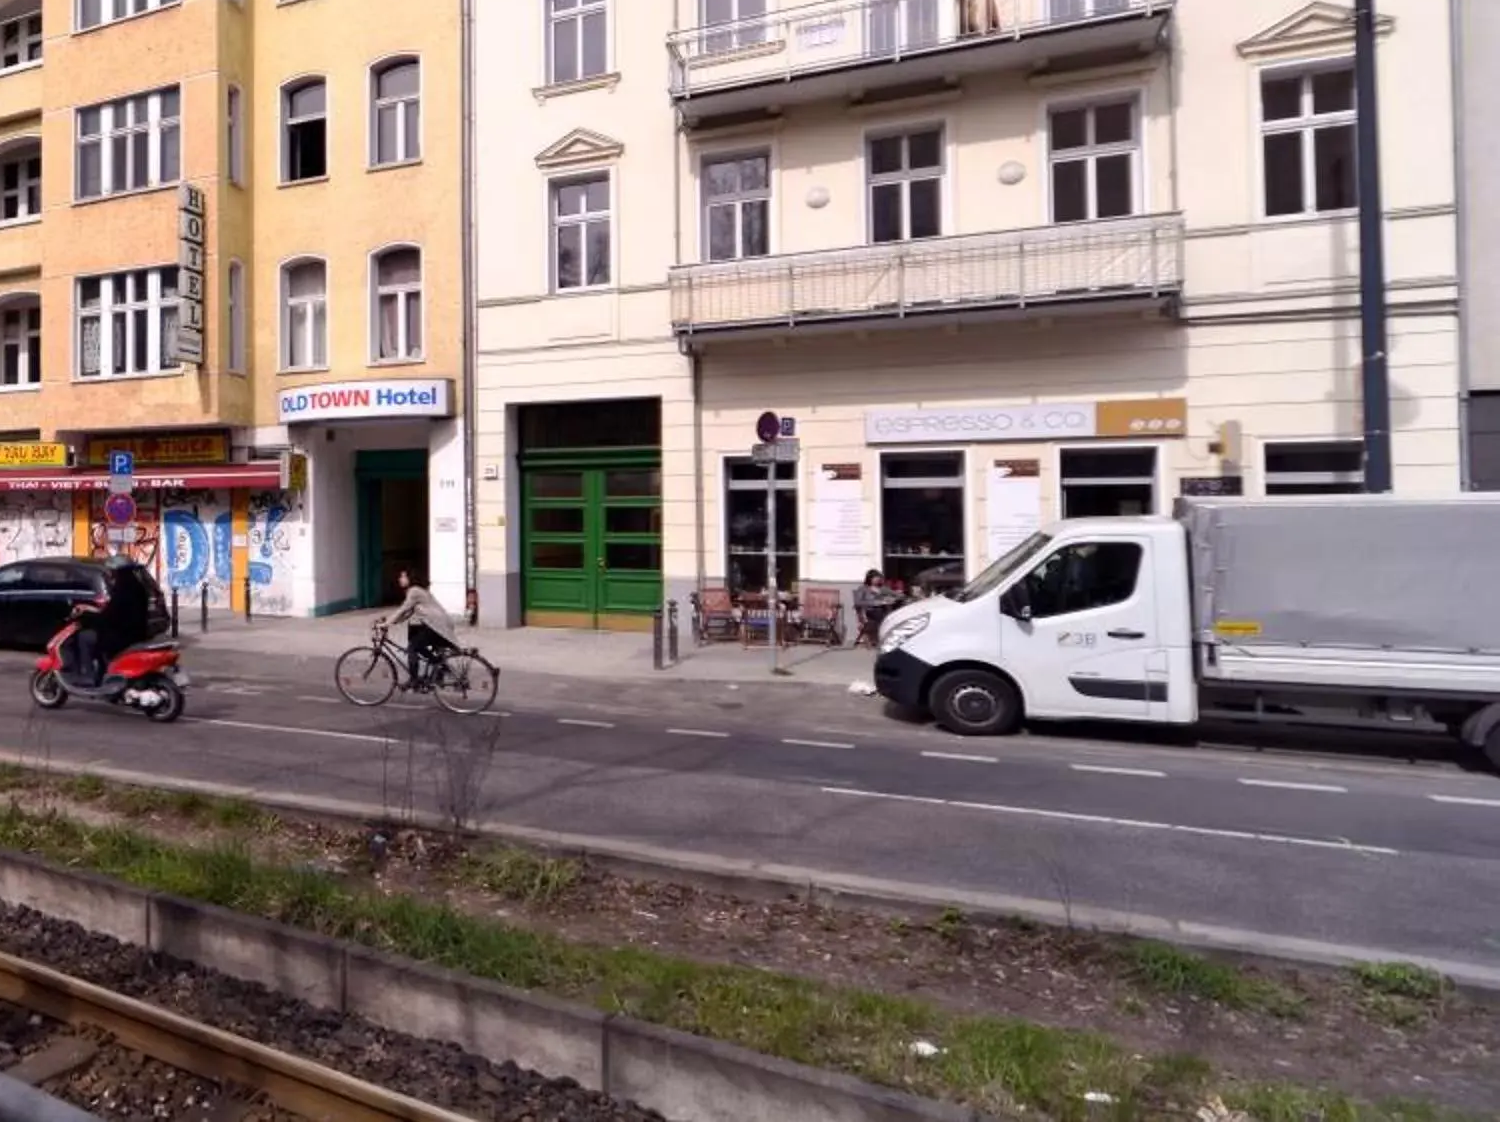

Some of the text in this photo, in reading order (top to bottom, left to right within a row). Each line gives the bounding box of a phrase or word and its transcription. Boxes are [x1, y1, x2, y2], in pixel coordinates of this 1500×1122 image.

[187, 186, 200, 324] HOTEL
[376, 387, 437, 406] Hotel
[115, 455, 127, 473] P
[8, 481, 39, 489] THAI
[51, 480, 82, 489] VIET
[150, 479, 185, 488] BAR
